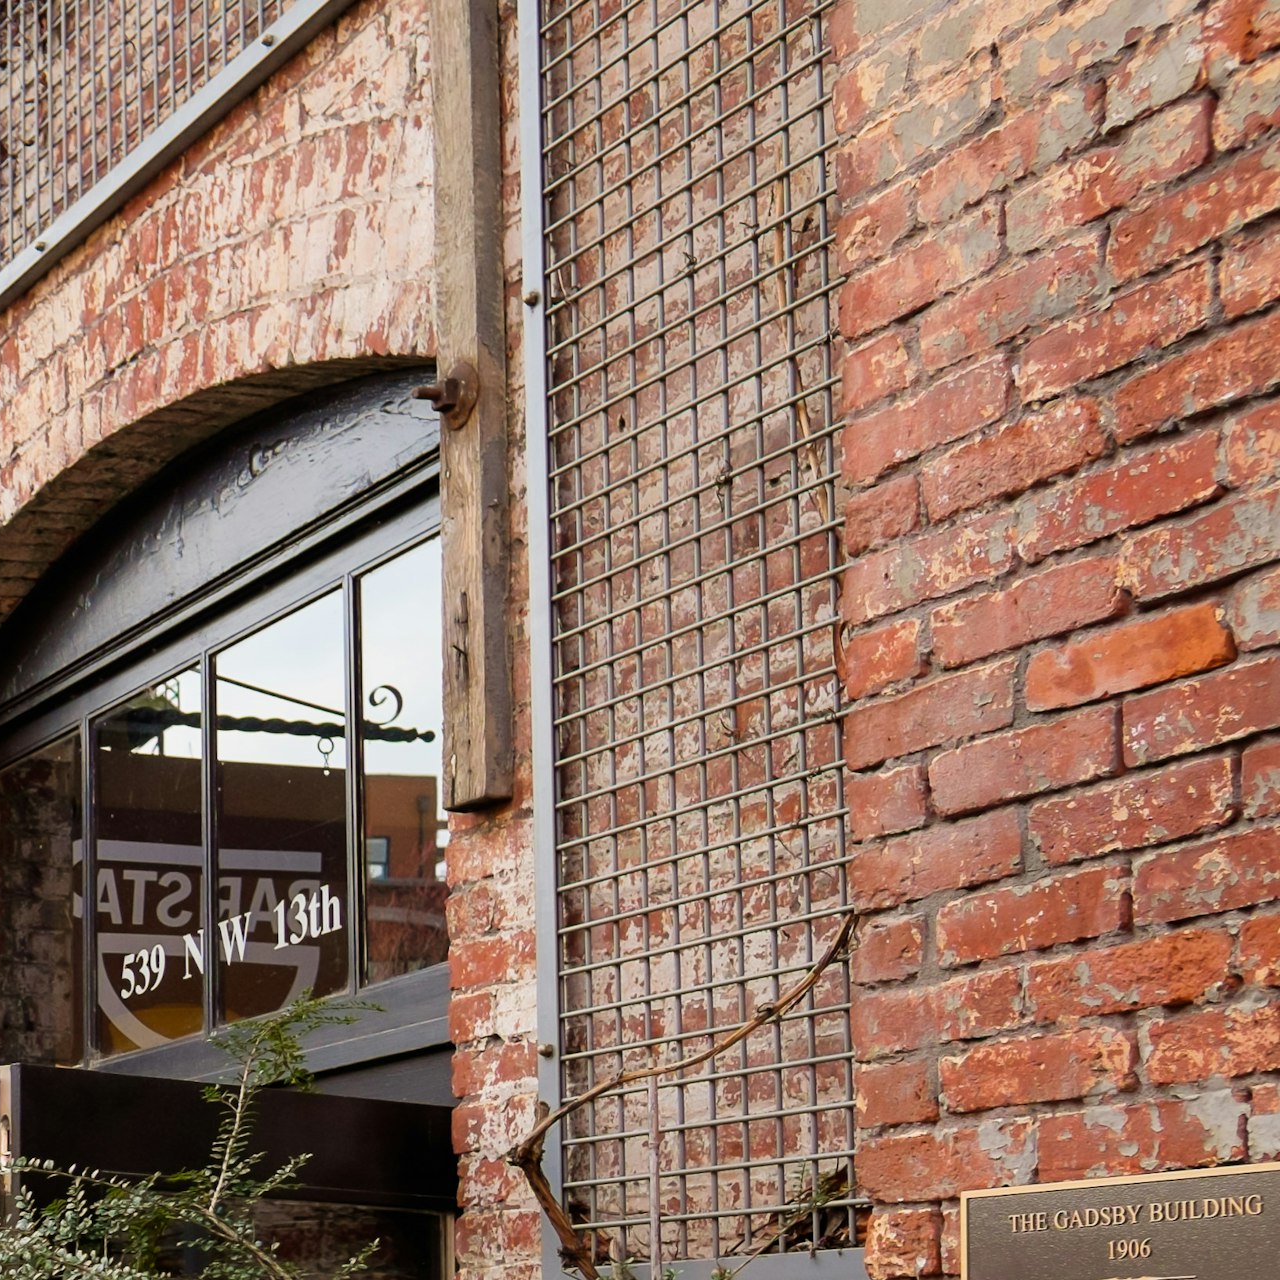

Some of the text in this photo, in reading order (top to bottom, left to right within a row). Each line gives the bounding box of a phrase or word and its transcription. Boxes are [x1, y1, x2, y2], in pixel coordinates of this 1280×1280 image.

[120, 943, 167, 1001] 539
[219, 911, 252, 967] W
[273, 884, 343, 950] 13th
[1009, 1194, 1264, 1233] THE GADSBY BUILDING
[1107, 1239, 1152, 1260] 1906
